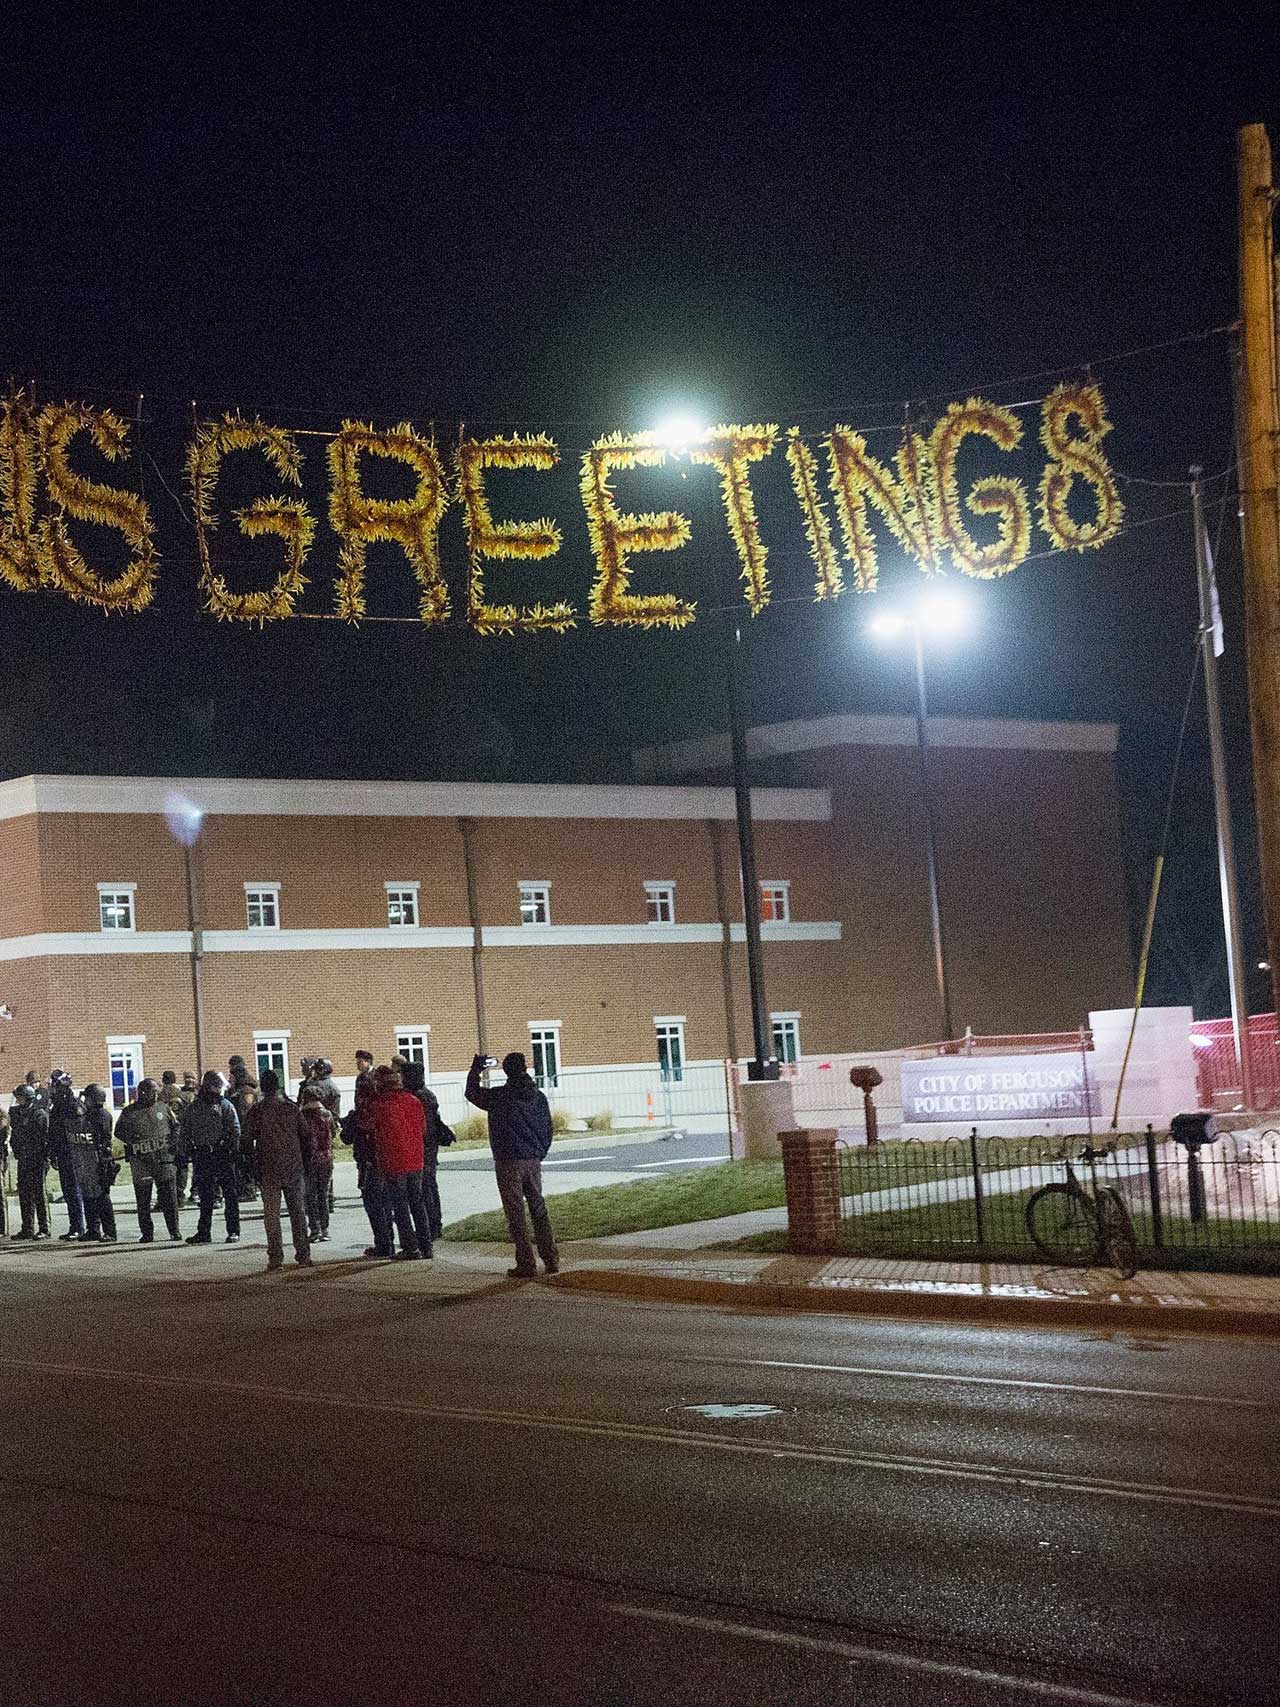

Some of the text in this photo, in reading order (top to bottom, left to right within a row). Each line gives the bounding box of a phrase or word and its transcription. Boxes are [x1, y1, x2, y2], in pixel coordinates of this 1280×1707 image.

[184, 381, 1125, 636] GREETINGS
[919, 1071, 1083, 1093] CITY OF FERGUSON
[914, 1096, 970, 1113] POLICE
[132, 1138, 168, 1154] POLICE
